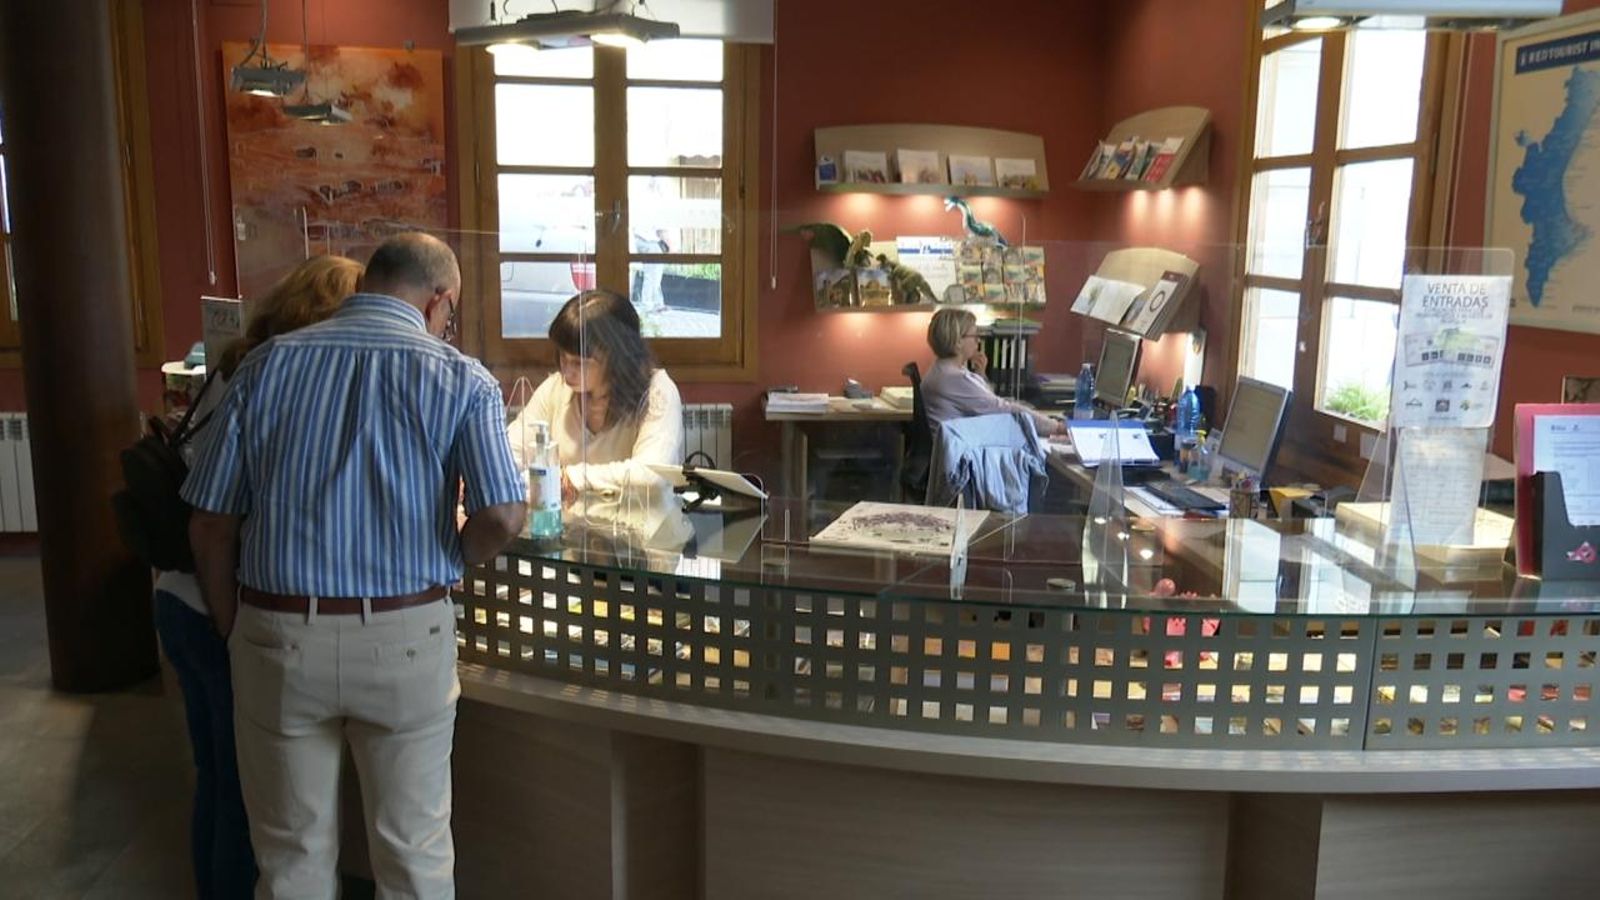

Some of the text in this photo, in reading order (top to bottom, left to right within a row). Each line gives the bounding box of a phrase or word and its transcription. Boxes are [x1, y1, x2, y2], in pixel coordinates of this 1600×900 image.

[1427, 283, 1487, 295] VENTA DE
[1422, 295, 1489, 309] ENTRADAS
